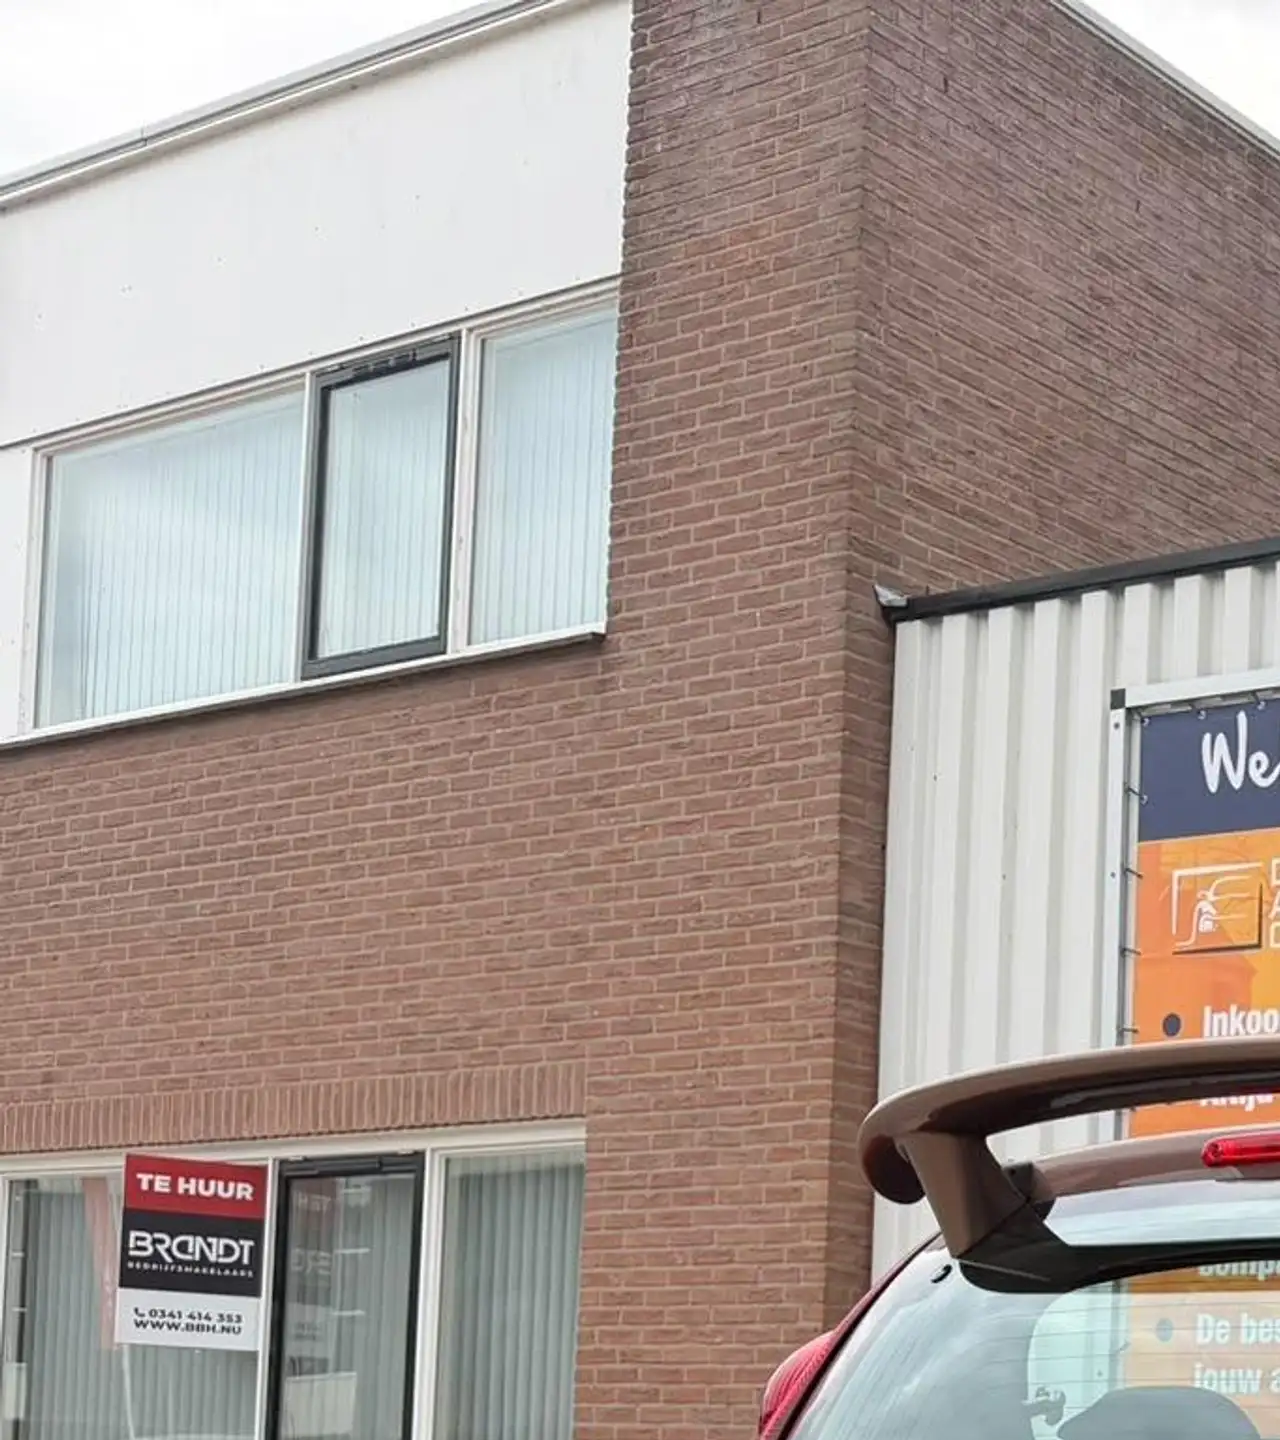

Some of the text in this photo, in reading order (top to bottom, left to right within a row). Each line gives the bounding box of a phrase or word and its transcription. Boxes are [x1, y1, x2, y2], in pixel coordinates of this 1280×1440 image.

[136, 1173, 254, 1201] TE HUUR
[128, 1230, 255, 1266] BRANDT
[148, 1308, 183, 1320] 0341
[187, 1310, 212, 1322] 414
[1197, 1313, 1231, 1346] De
